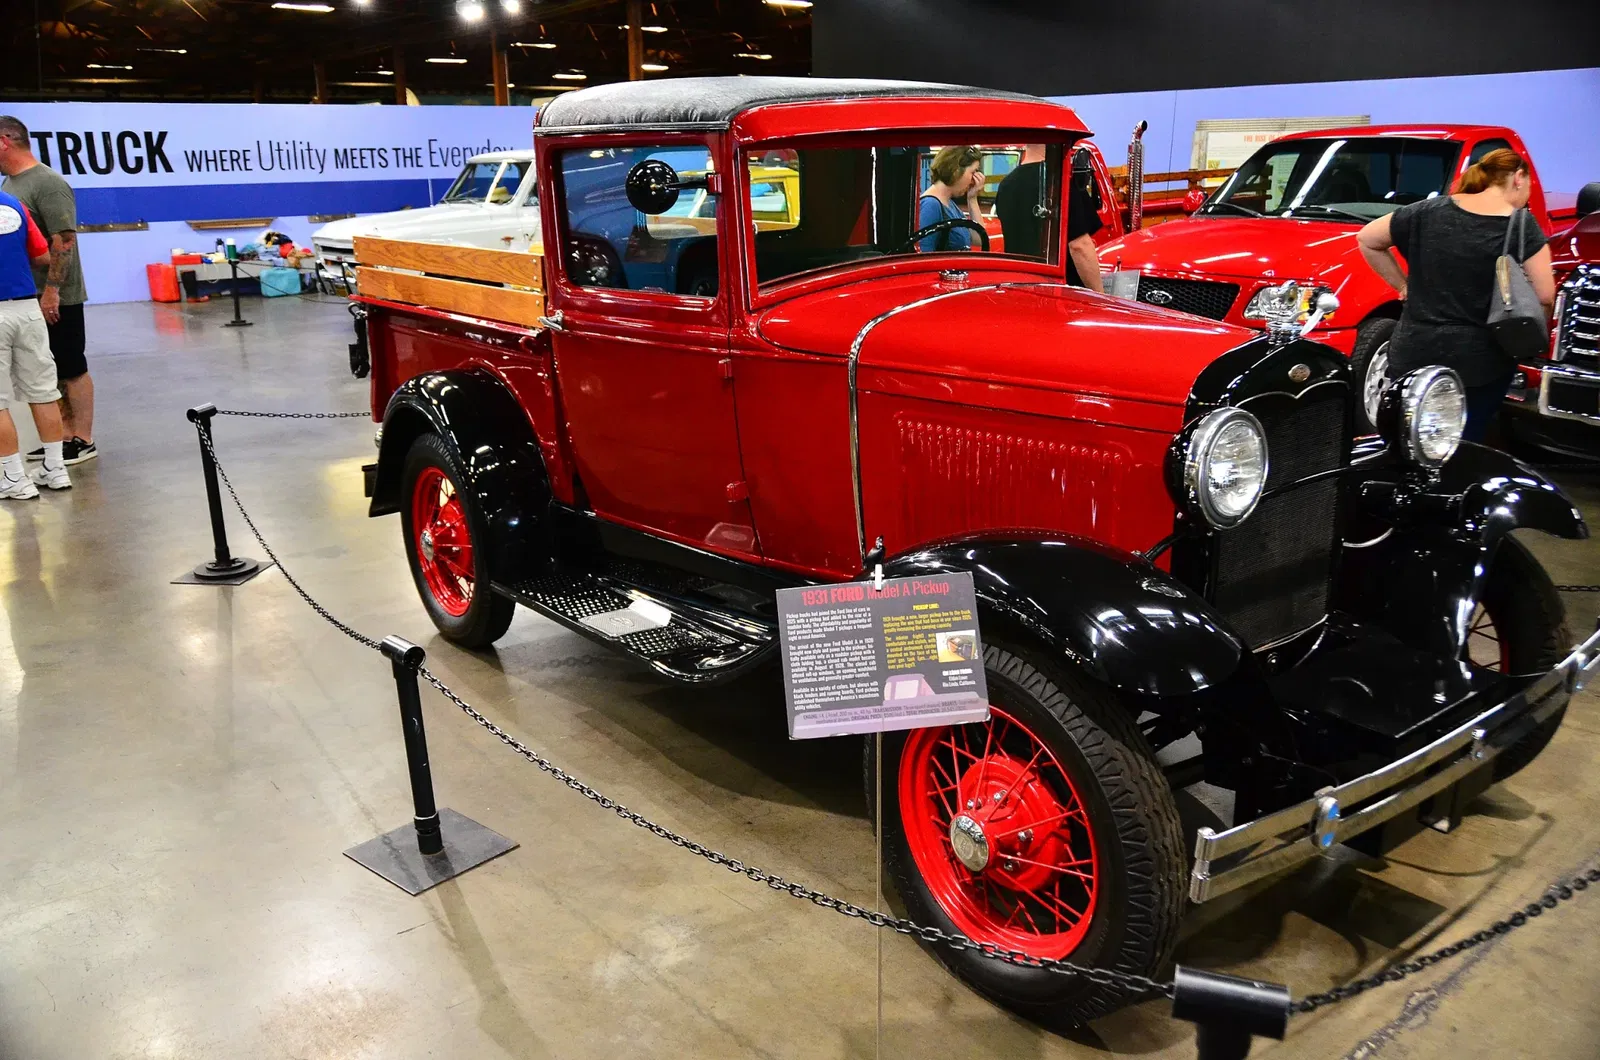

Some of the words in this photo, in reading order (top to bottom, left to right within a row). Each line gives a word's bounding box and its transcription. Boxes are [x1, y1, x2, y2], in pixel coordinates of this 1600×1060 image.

[30, 131, 174, 175] TRUCK
[184, 149, 253, 172] WHERE
[256, 140, 326, 174] Utility
[333, 147, 389, 169] MEETS
[392, 147, 424, 168] THE
[801, 589, 829, 605] 1931
[830, 586, 865, 603] FORD
[866, 584, 900, 599] Model
[902, 583, 911, 596] A
[912, 580, 950, 595] Pickup
